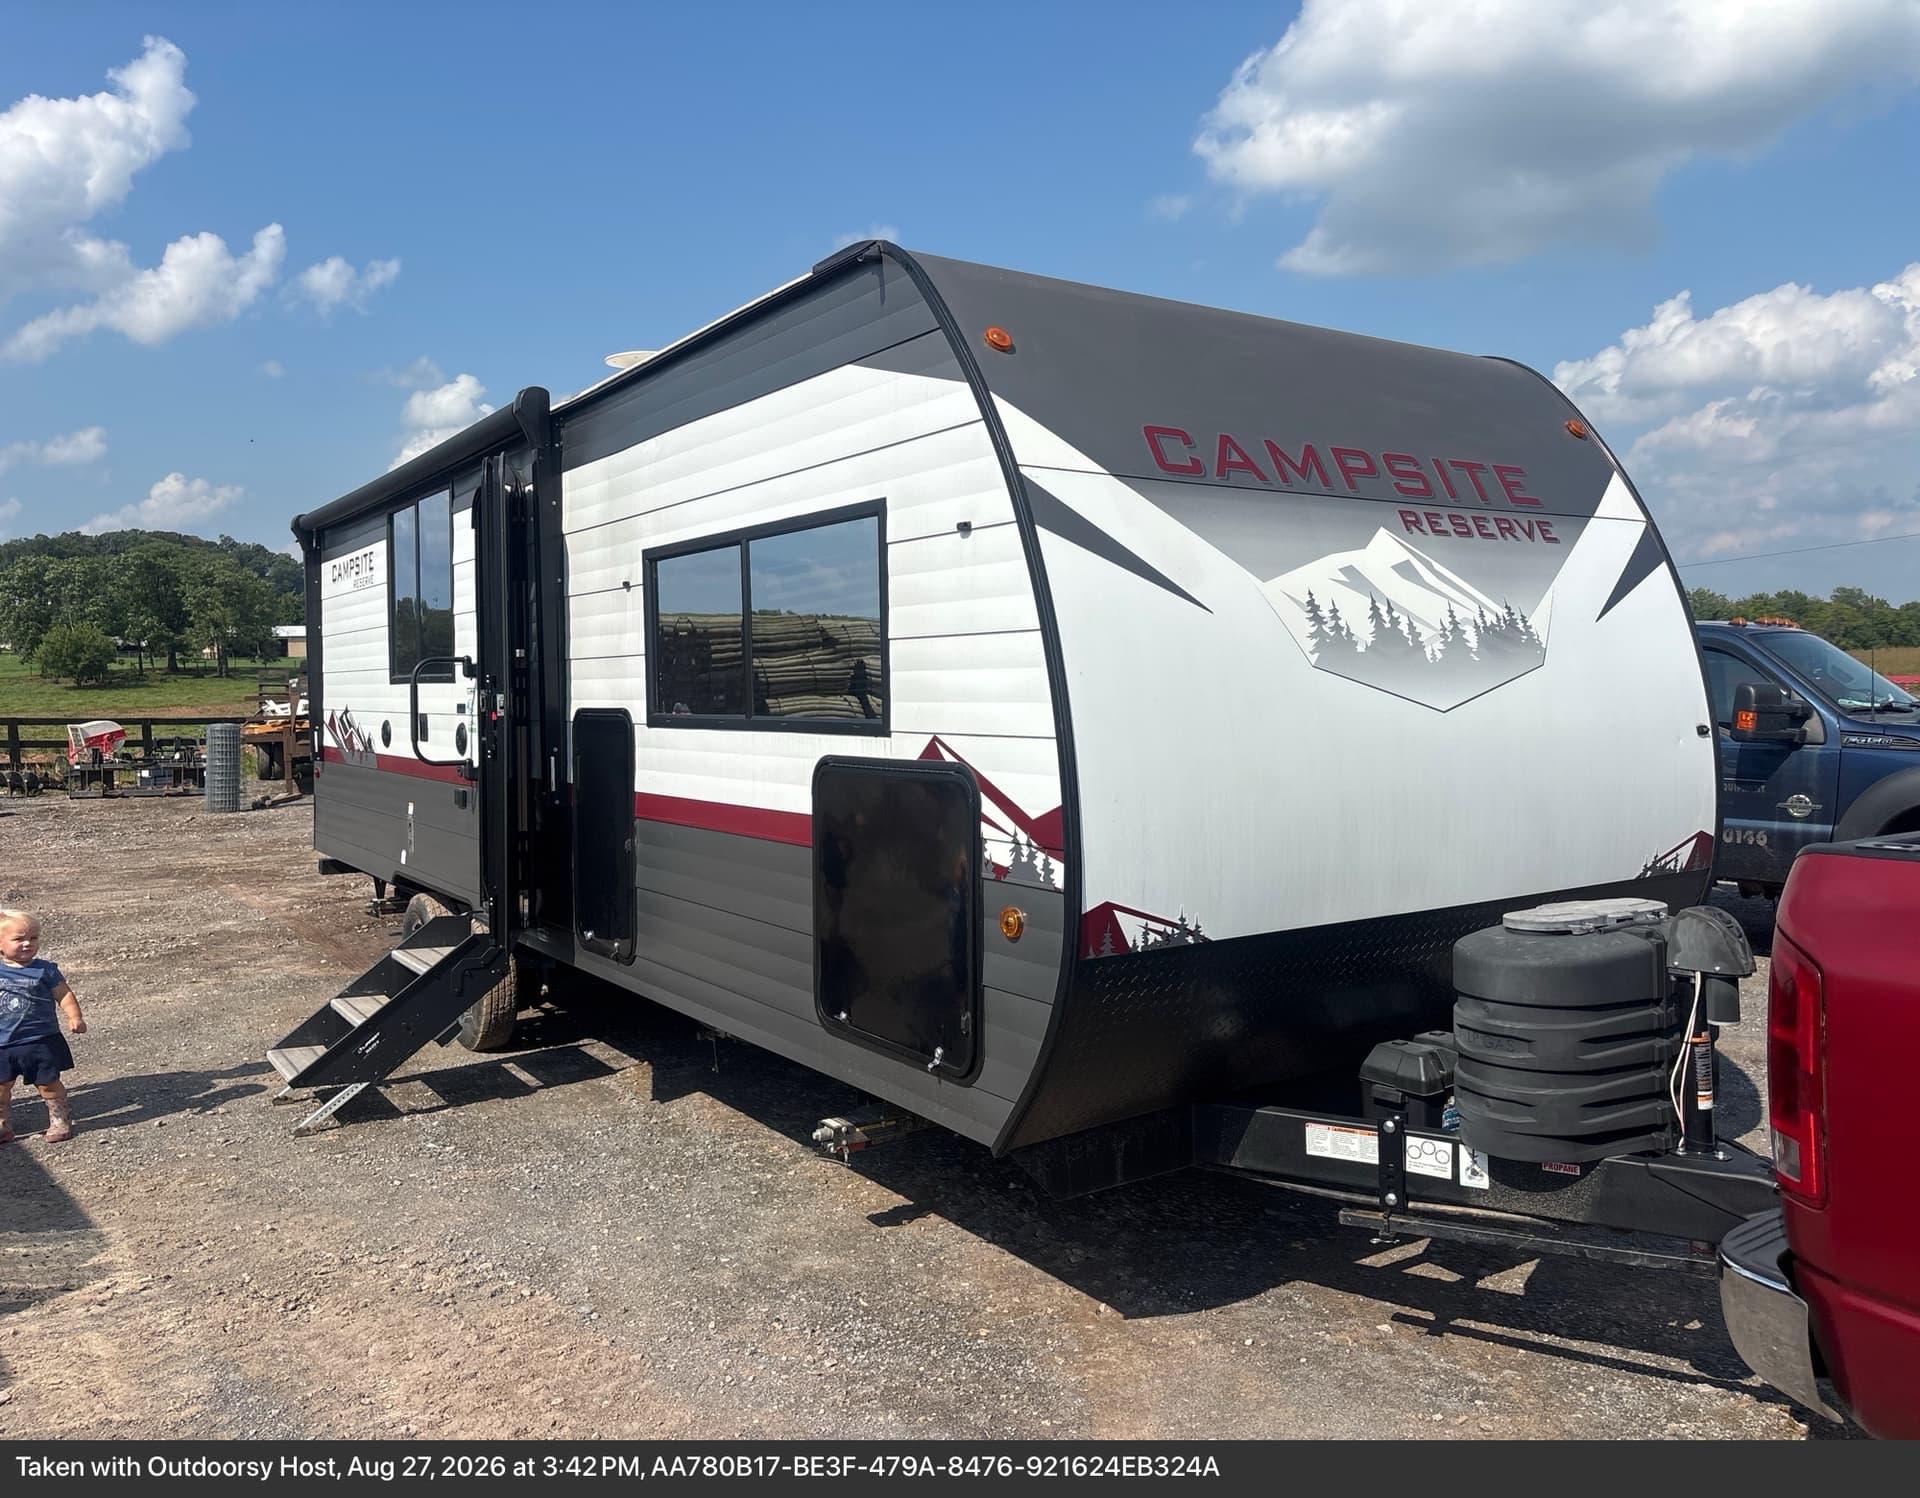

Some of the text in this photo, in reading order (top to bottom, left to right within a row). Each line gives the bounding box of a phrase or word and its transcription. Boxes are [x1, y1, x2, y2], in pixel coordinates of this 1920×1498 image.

[1142, 424, 1544, 507] CAMPSITE
[1398, 508, 1561, 544] RESERVE
[332, 551, 373, 582] CAMPSITE
[1543, 1161, 1579, 1174] PROPANE
